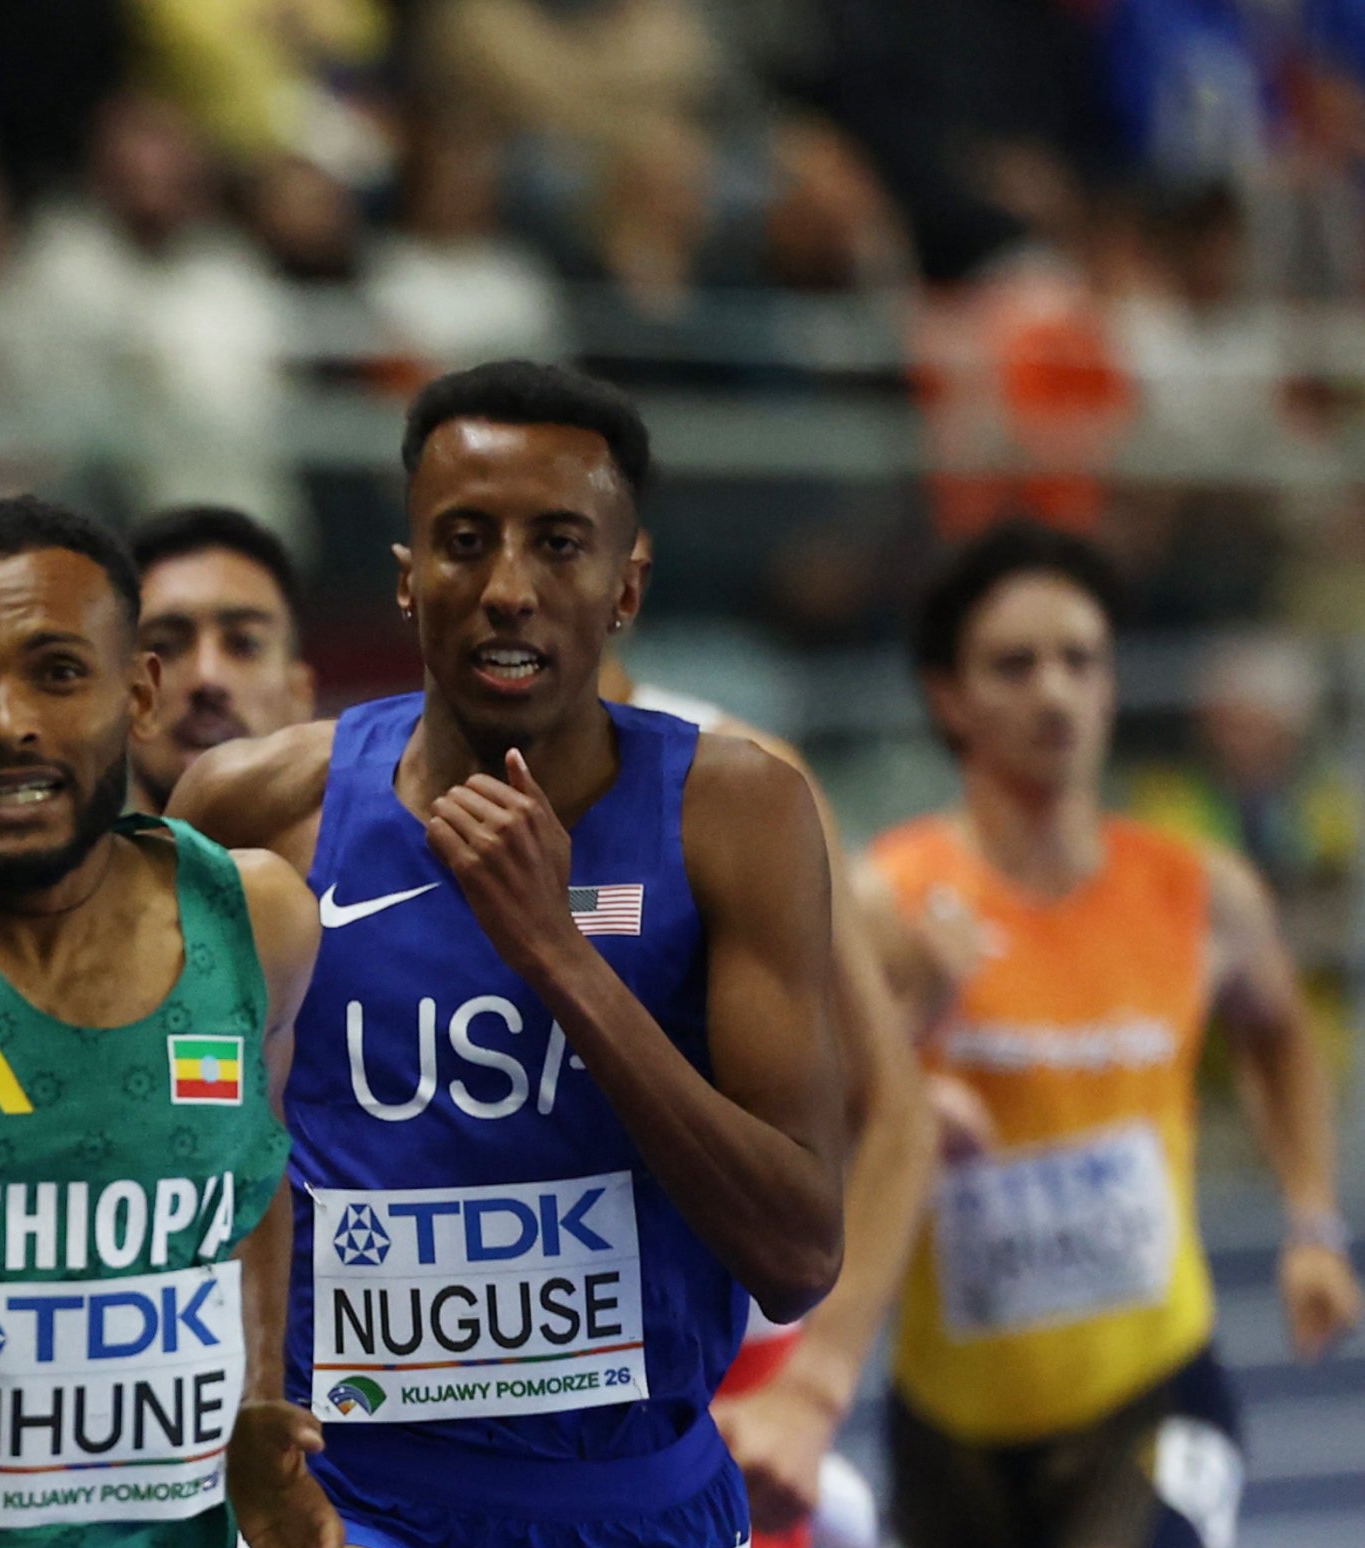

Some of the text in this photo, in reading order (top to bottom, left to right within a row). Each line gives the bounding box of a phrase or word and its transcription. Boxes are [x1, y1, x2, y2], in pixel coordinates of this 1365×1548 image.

[387, 1187, 614, 1265] TDK
[6, 1279, 220, 1362] TDK
[333, 1271, 622, 1356] NUGUSE
[401, 1366, 631, 1404] KUJAWY POMORZE 26
[3, 1485, 96, 1509] KUJAWY
